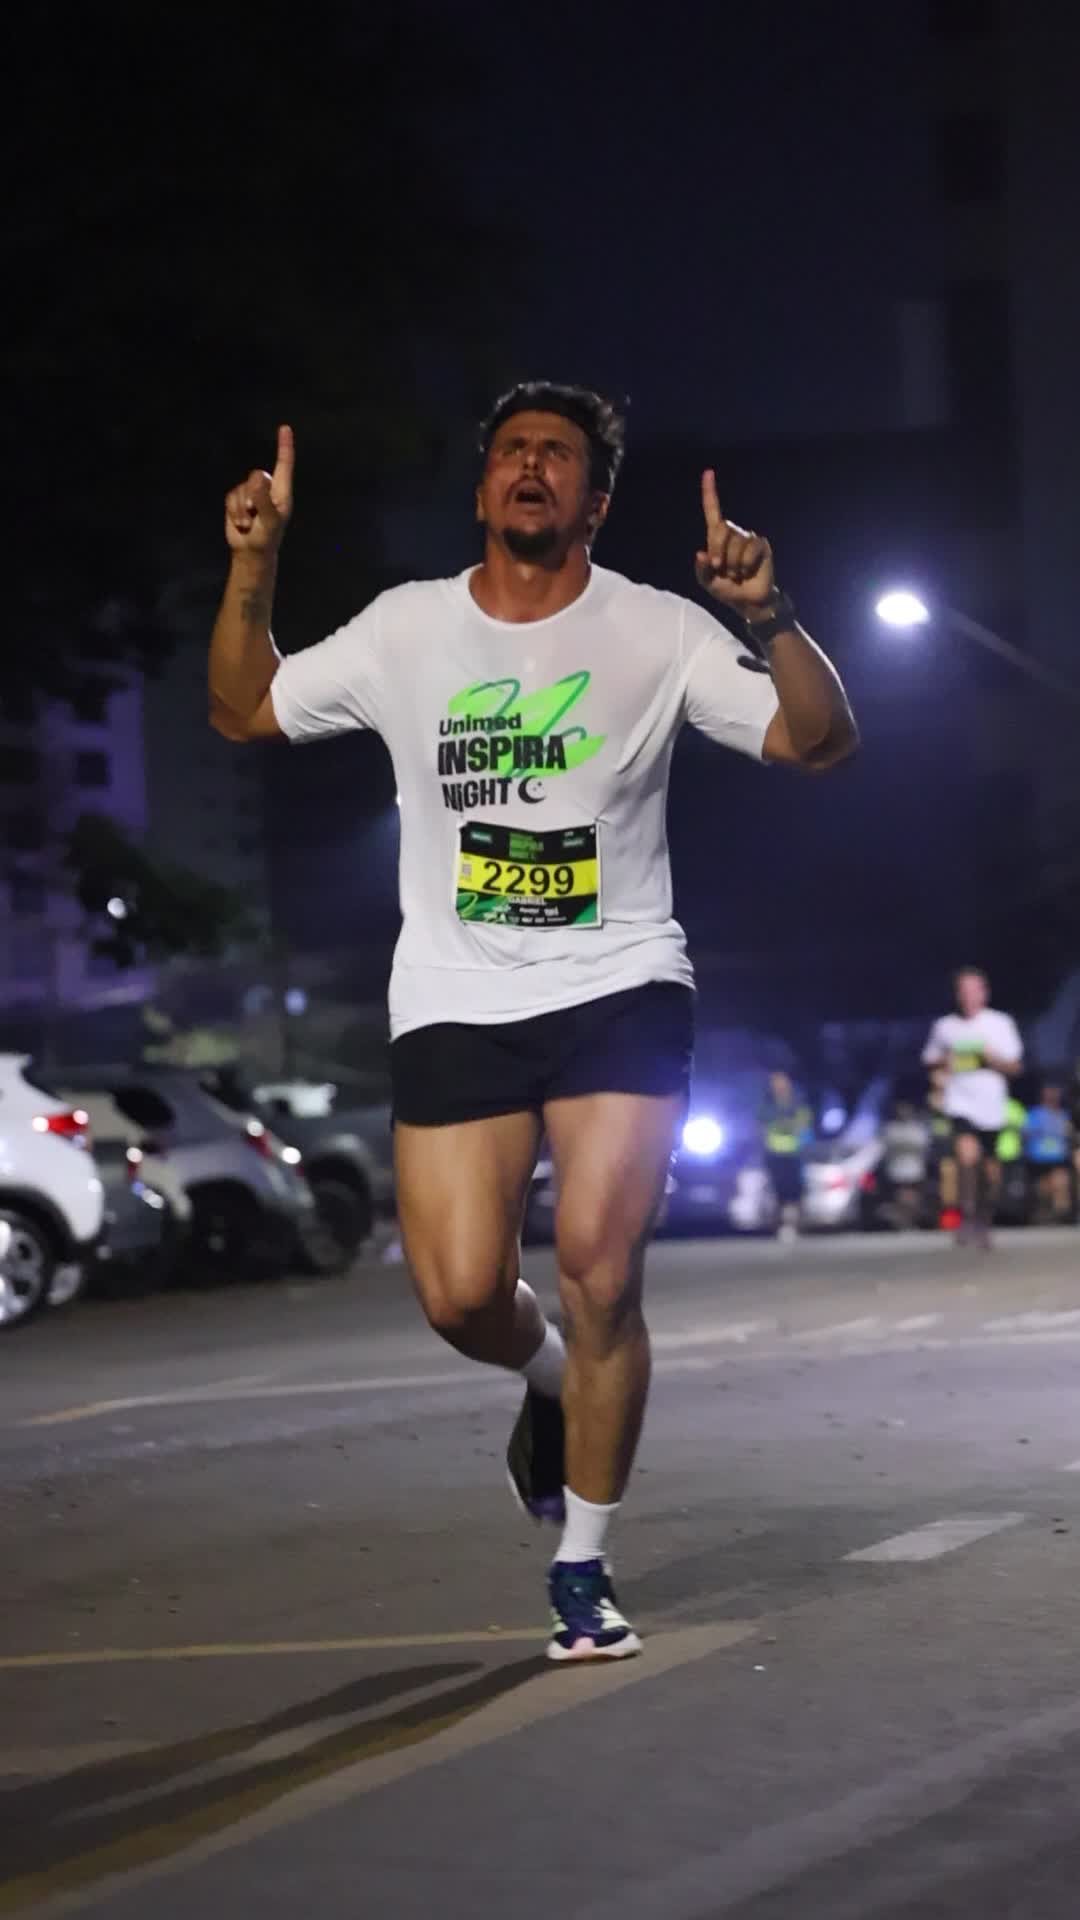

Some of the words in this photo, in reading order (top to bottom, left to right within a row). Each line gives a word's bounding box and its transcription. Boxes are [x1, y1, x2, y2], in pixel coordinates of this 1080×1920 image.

[439, 713, 522, 737] Unimed
[437, 734, 567, 776] INSPIRA
[482, 860, 575, 896] 2299
